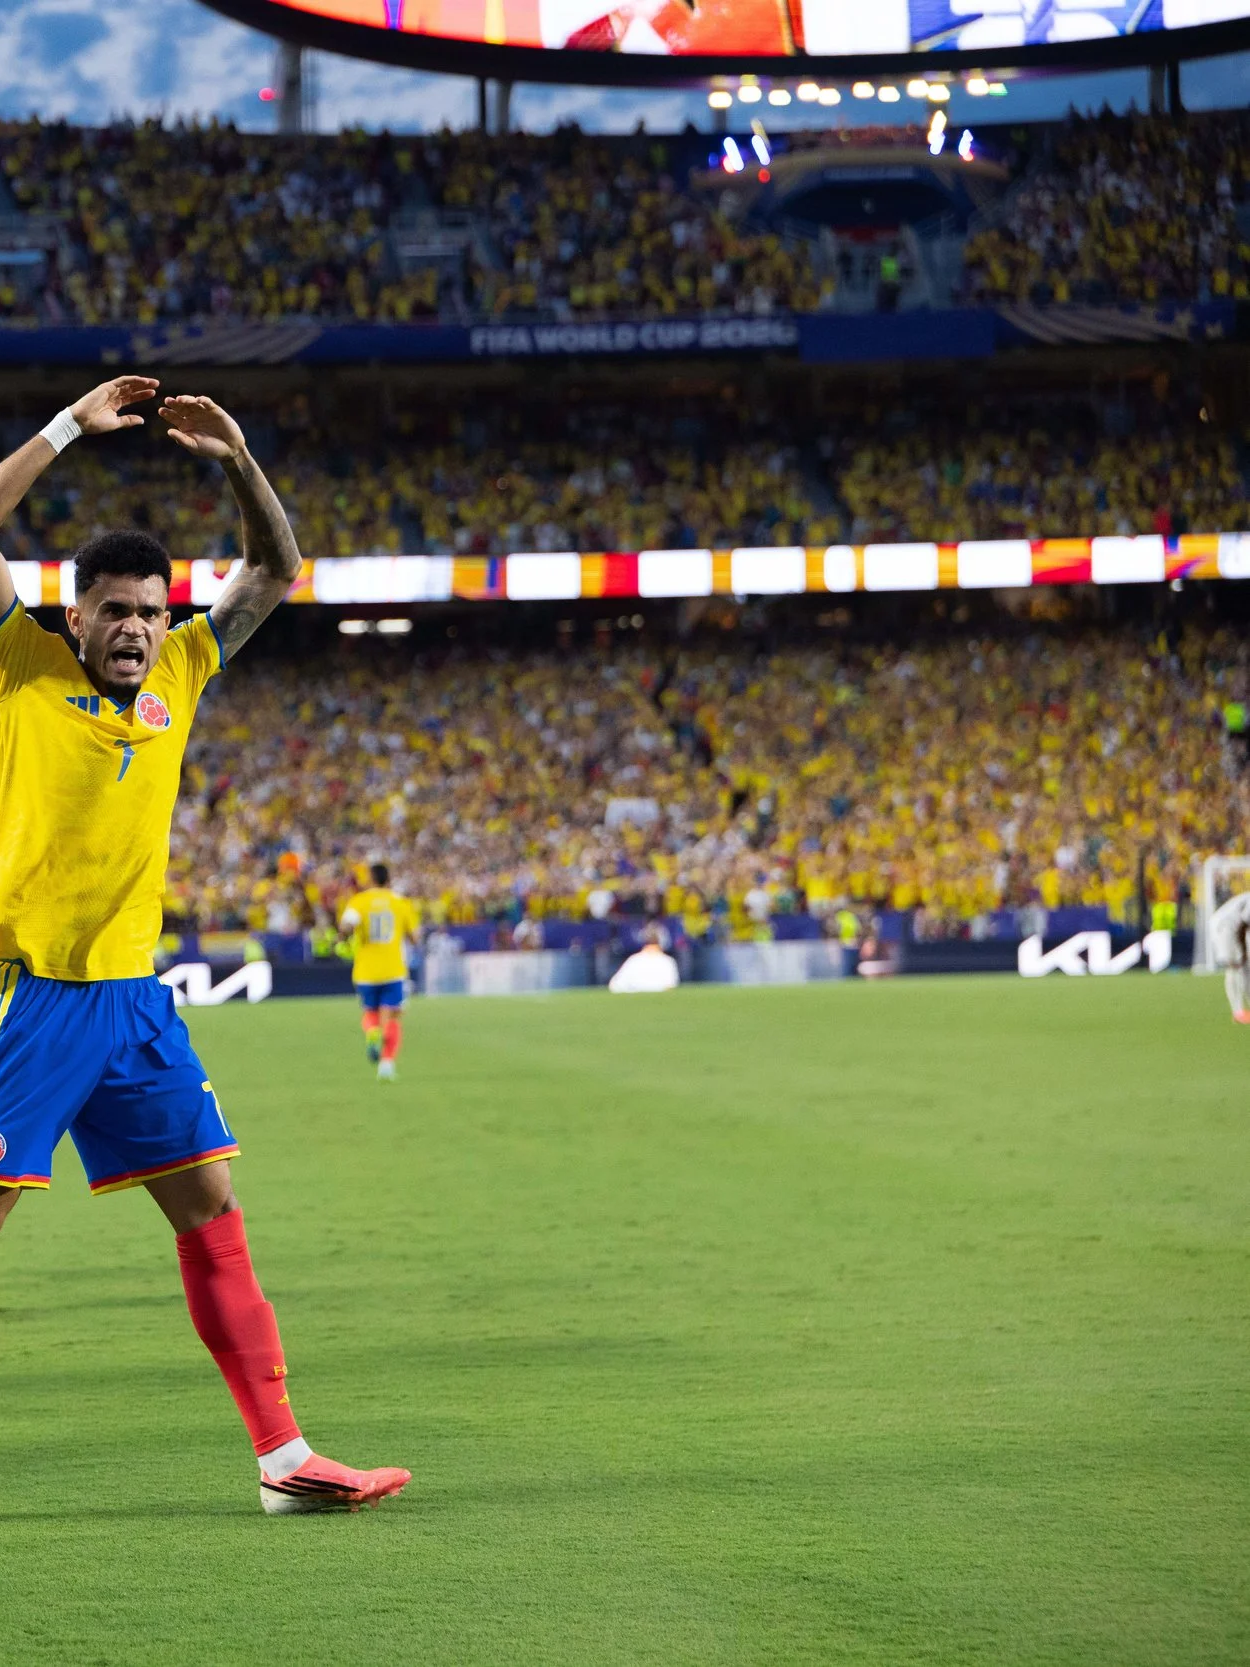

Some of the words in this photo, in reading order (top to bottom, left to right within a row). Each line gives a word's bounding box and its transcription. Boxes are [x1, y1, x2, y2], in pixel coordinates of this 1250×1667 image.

[470, 325, 532, 355] FIFA
[534, 323, 636, 352] WORLD
[639, 321, 696, 349] CUP
